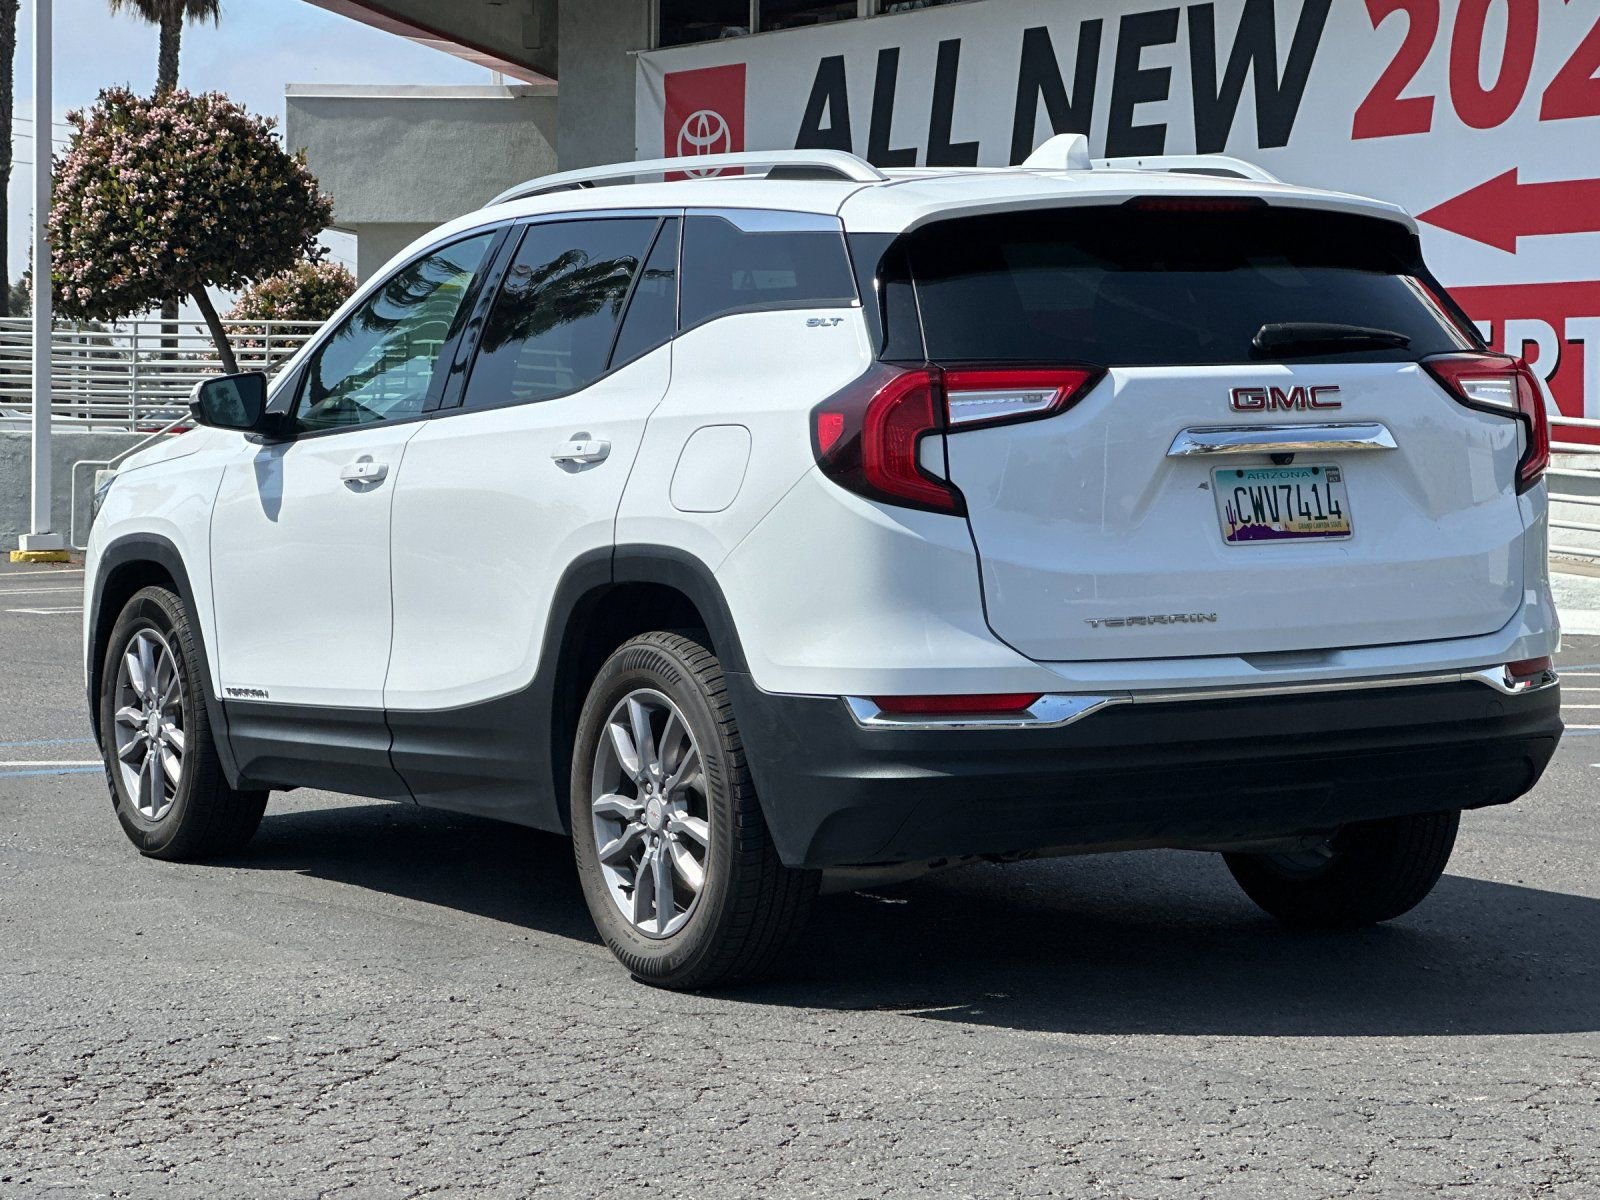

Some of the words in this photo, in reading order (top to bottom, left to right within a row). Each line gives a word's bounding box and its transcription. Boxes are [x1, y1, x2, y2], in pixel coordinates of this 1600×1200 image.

[794, 37, 980, 168] ALL
[1009, 0, 1333, 167] NEW
[806, 317, 844, 328] SLT
[1228, 385, 1342, 412] GMC
[1247, 471, 1311, 480] ARIZONA
[1233, 483, 1342, 524] CWV7414
[1085, 613, 1217, 628] TERRAIN
